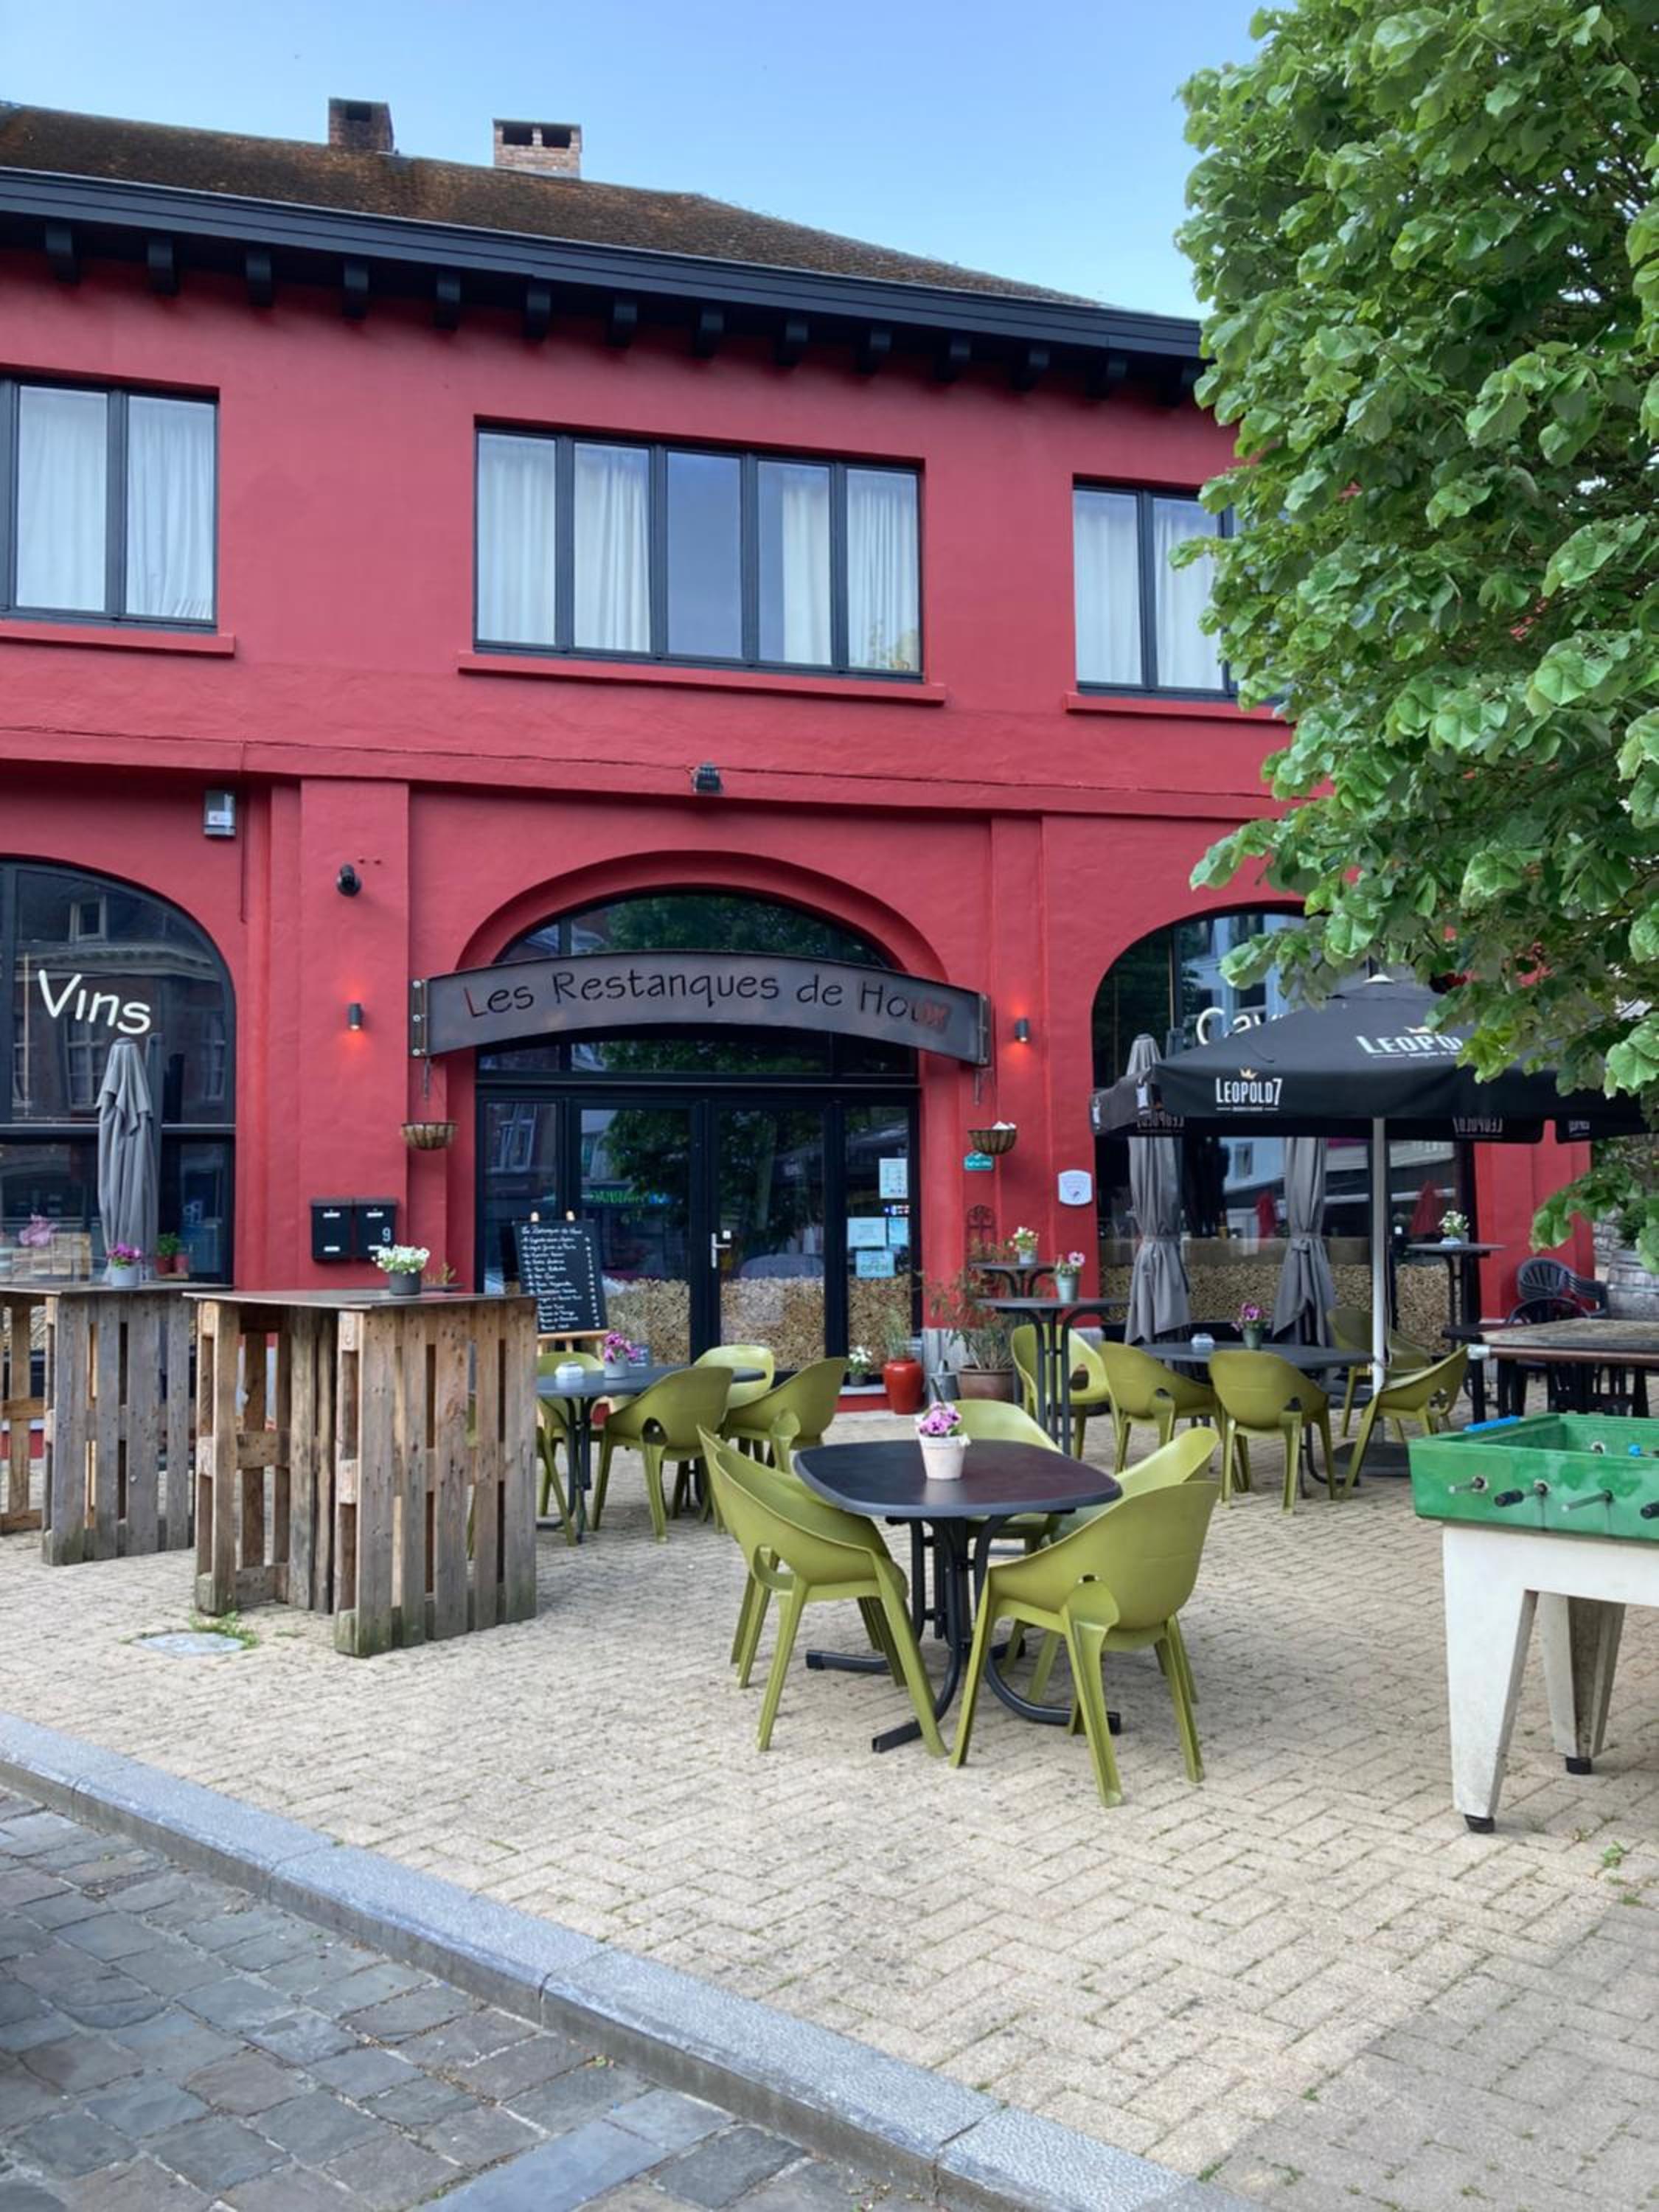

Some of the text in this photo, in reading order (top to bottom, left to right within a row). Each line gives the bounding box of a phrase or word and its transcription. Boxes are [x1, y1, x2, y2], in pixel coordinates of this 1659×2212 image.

[40, 969, 151, 1034] Vins
[464, 986, 535, 1018] Les
[552, 969, 779, 1008] Restanques
[796, 974, 843, 1006] de
[1356, 1035, 1464, 1053] LEOPO
[1215, 1077, 1283, 1106] LEOPOLD7
[382, 1227, 392, 1242] 9
